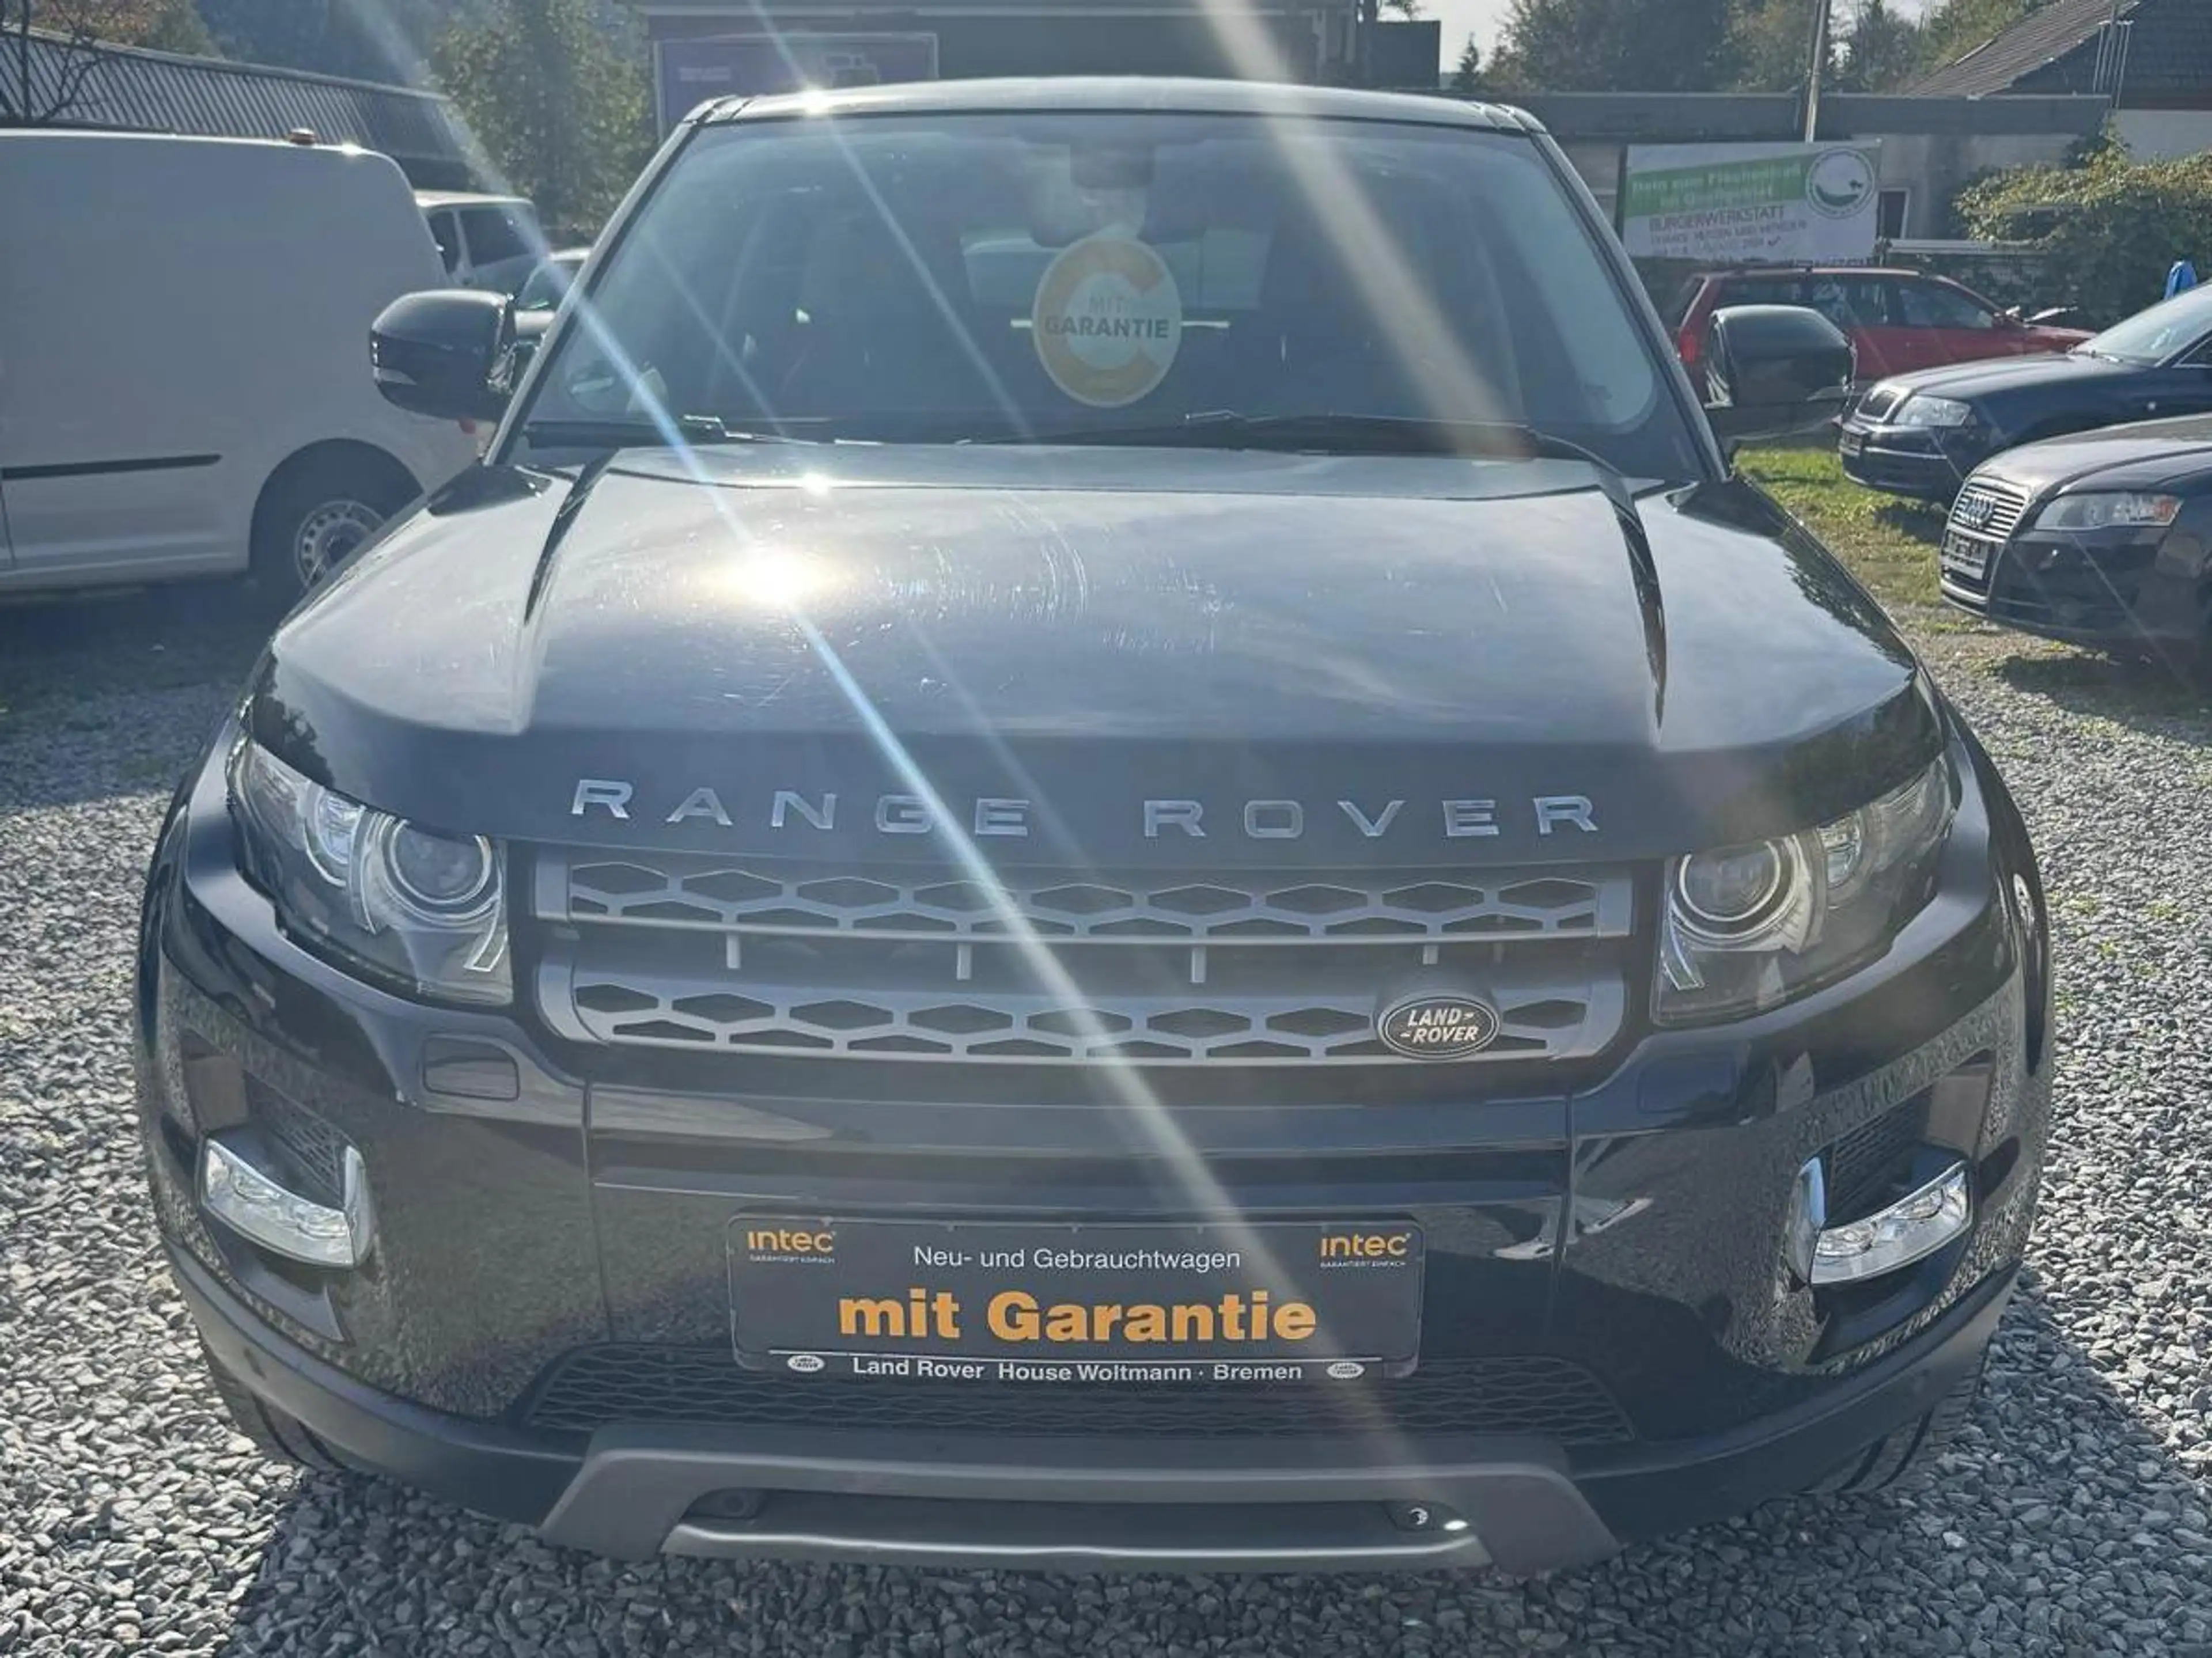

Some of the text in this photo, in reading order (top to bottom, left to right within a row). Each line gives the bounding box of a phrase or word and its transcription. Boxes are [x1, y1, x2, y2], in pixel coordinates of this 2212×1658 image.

[1045, 316, 1169, 339] GARANTIE
[571, 779, 1599, 839] RANGE ROVER
[1407, 1008, 1462, 1026] LAND
[1412, 1025, 1479, 1043] ROVER
[748, 1228, 834, 1253] intec
[1321, 1233, 1408, 1257] intec
[915, 1246, 1240, 1273] Neu- und Gebrauchtwagen
[839, 1287, 1316, 1342] mit Garantie
[853, 1356, 1302, 1382] Land Rover House Woltmann Bremen
